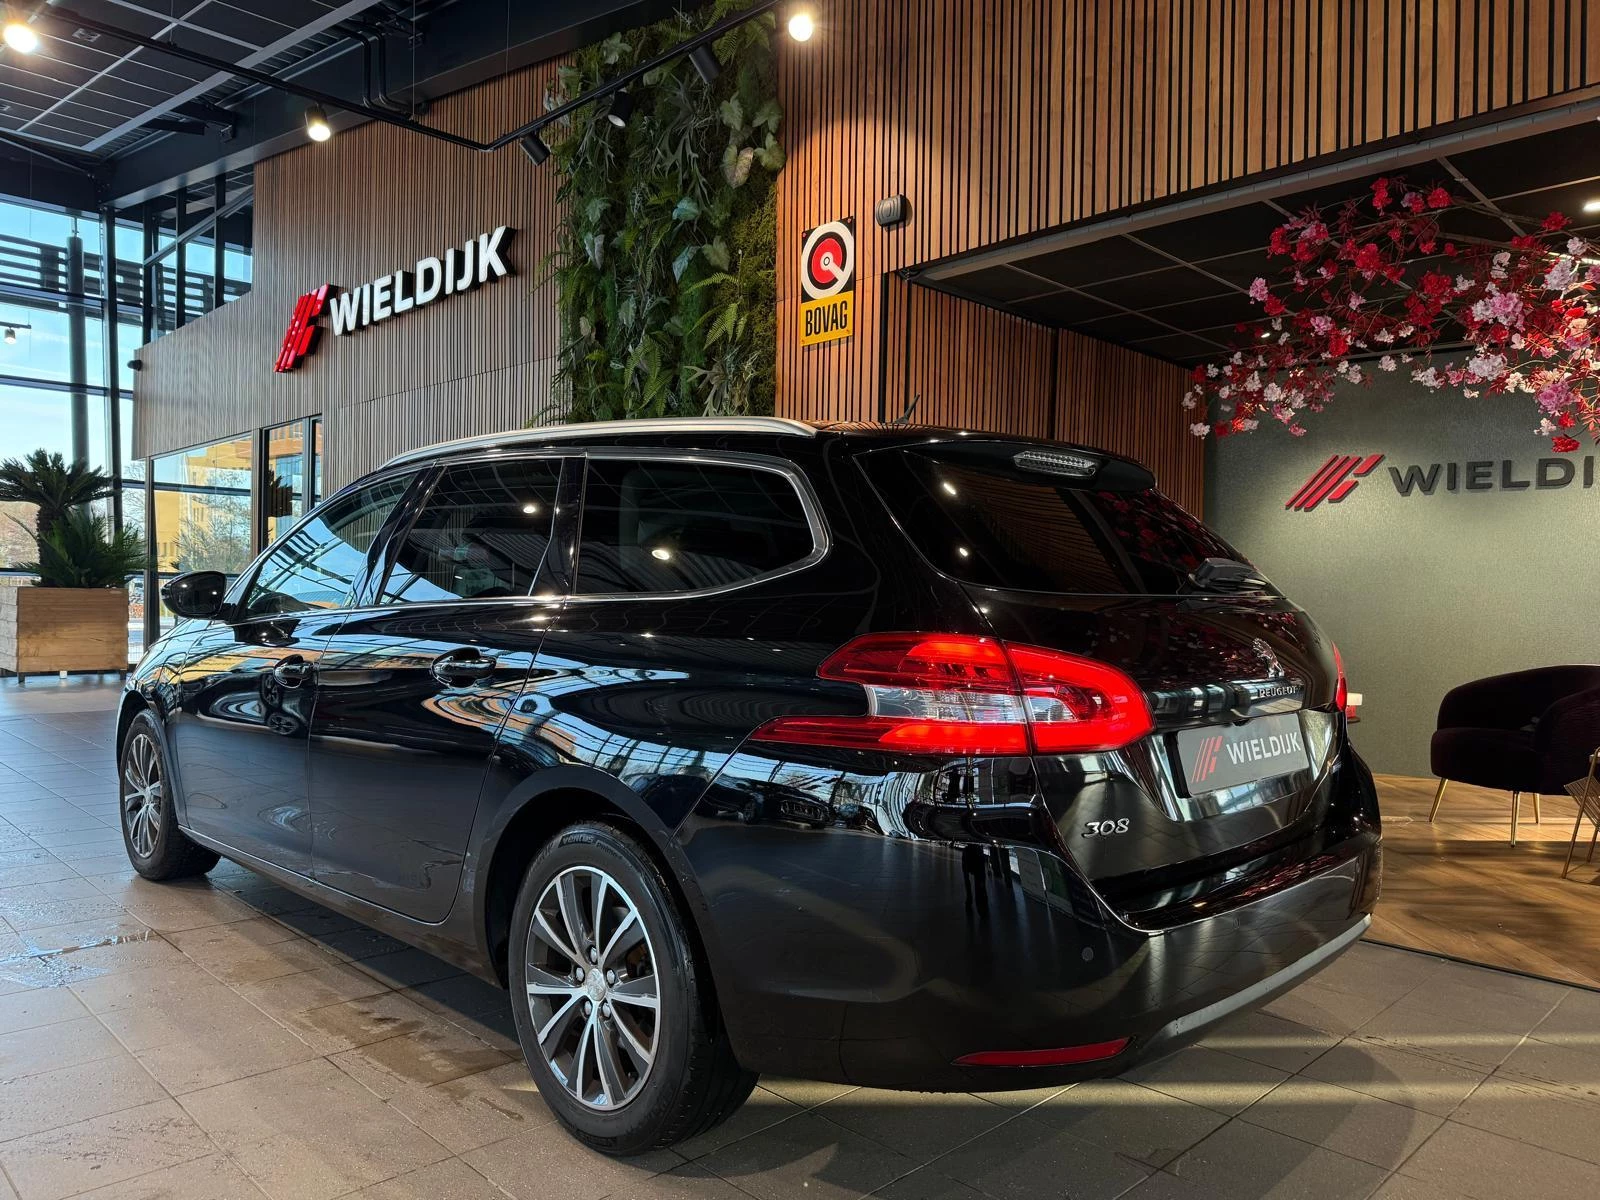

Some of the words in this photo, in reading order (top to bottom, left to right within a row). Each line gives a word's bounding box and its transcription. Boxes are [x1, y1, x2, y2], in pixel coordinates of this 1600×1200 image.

[329, 225, 507, 336] WIELDIJK
[805, 300, 848, 337] BOVAG
[1258, 685, 1297, 698] PEUGEOT
[1226, 731, 1301, 765] WIELDIJK
[1082, 818, 1130, 838] 308
